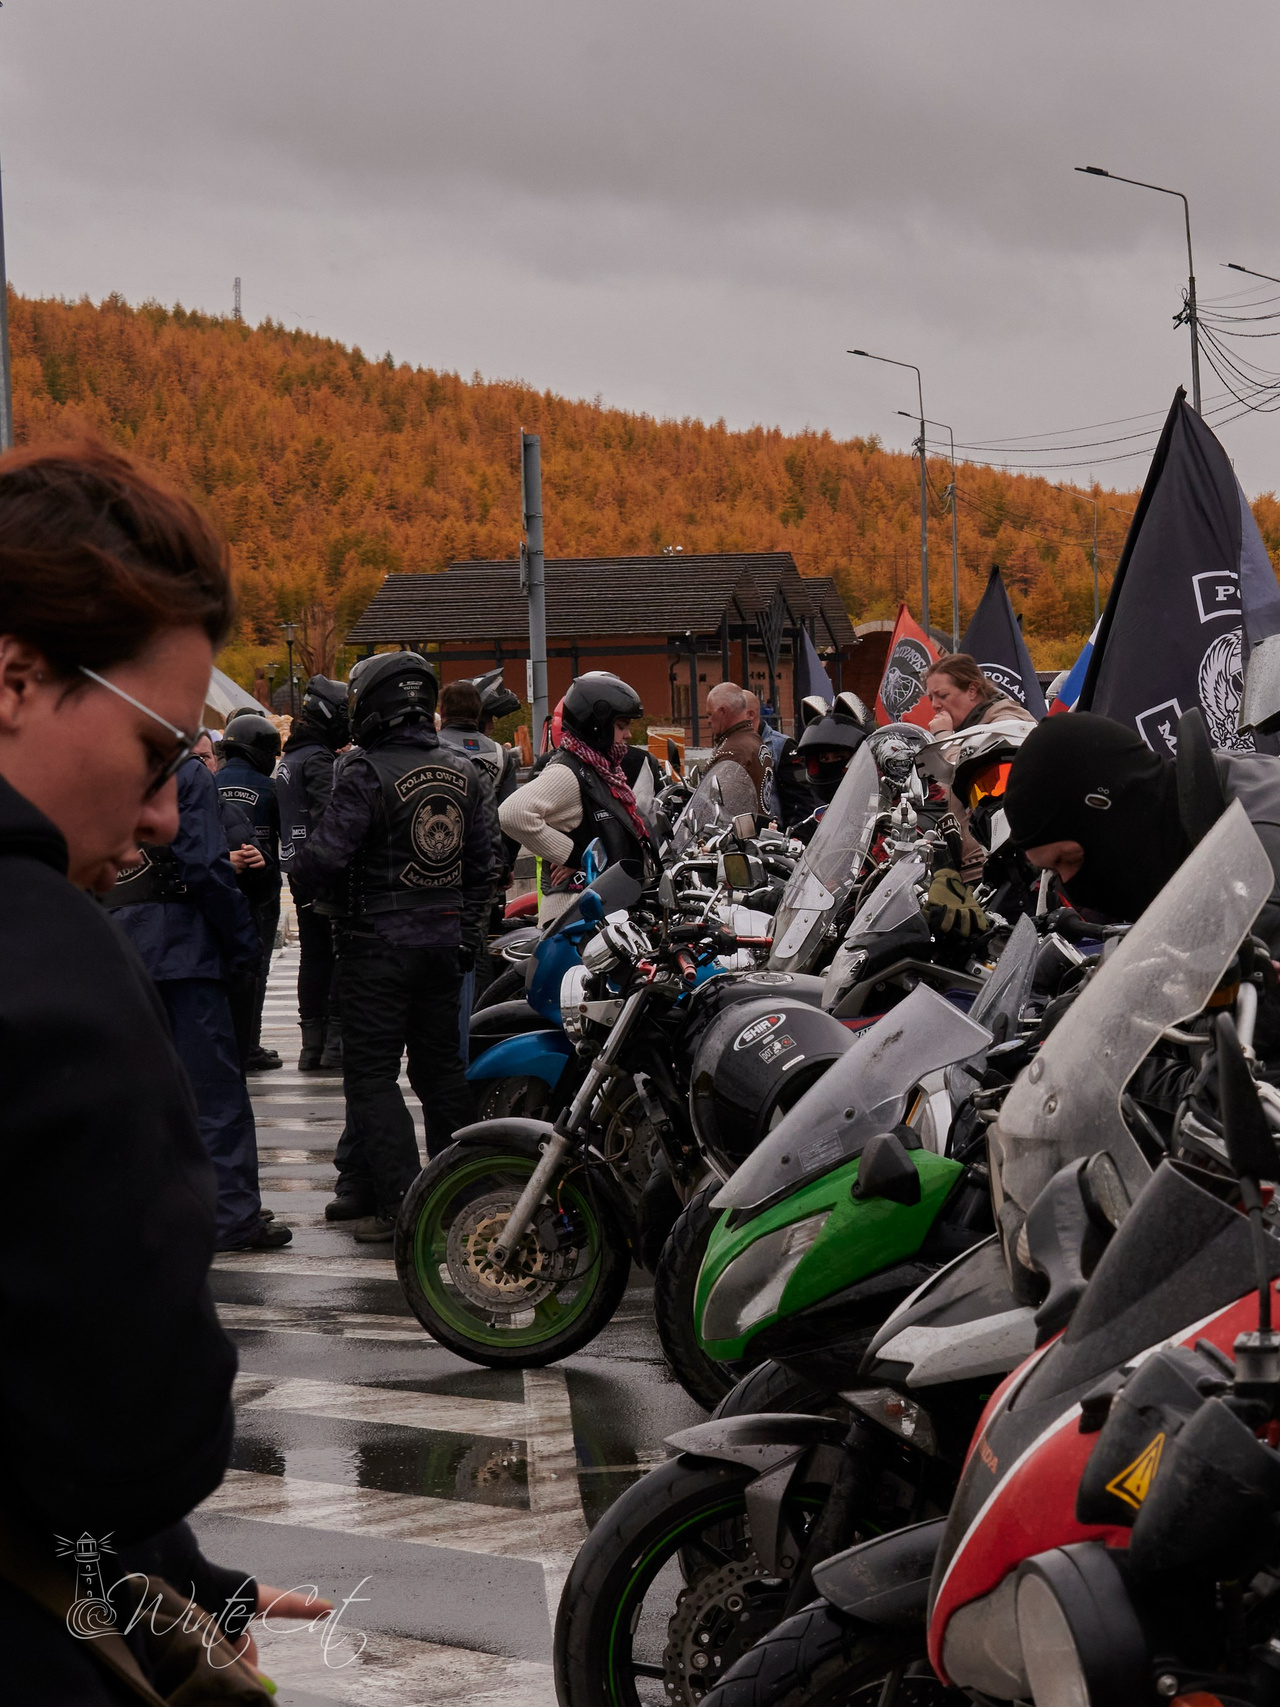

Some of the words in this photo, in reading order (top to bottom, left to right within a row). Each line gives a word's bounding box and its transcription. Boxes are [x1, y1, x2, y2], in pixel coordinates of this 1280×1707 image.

[400, 771, 434, 794] POLAR
[435, 771, 465, 788] OWLS
[233, 790, 256, 801] OWLS
[407, 869, 460, 887] MAGADAN
[761, 1048, 775, 1060] DOT
